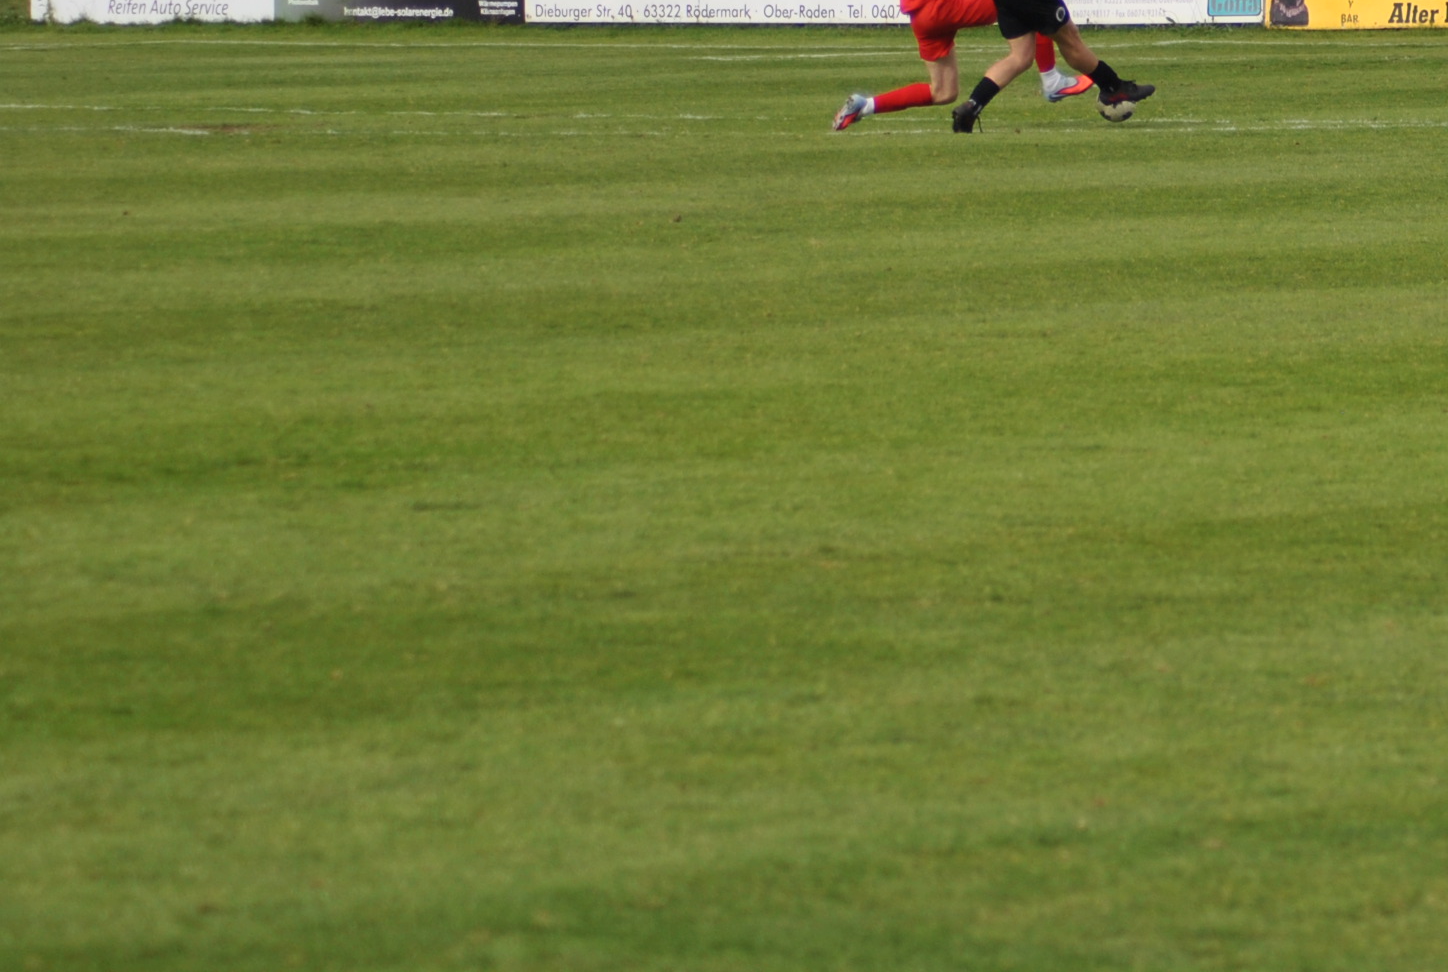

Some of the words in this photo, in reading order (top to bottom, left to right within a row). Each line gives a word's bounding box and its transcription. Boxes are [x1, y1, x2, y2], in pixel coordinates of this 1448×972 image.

[150, 0, 182, 16] Auto
[184, 0, 229, 16] Service
[535, 4, 593, 21] Dieburger
[618, 4, 633, 18] 40
[643, 4, 682, 19] 63322
[686, 3, 751, 19] Rödermark
[763, 4, 835, 19] Ober-Roden
[847, 4, 867, 19] Tel.
[871, 4, 905, 19] 0607
[1388, 2, 1439, 24] Alter
[1341, 13, 1359, 25] BAR
